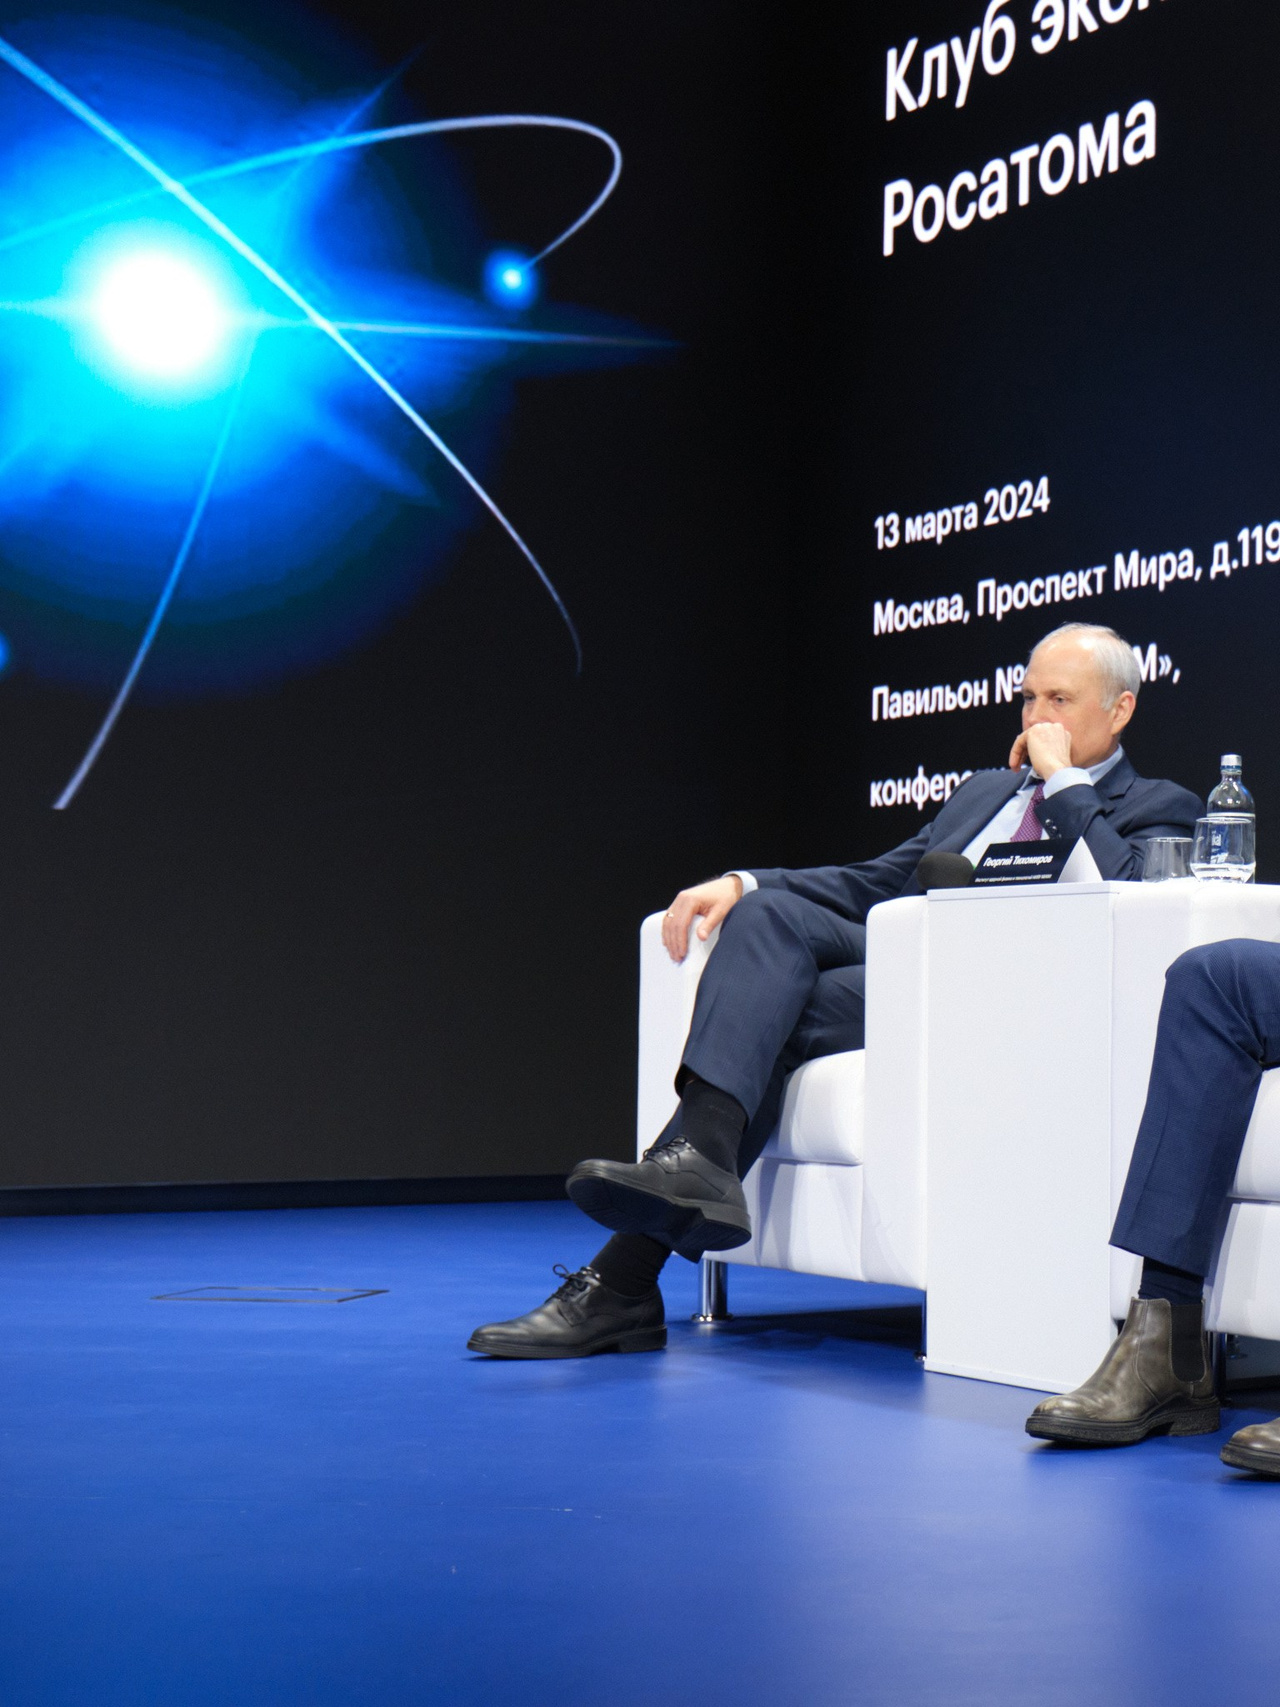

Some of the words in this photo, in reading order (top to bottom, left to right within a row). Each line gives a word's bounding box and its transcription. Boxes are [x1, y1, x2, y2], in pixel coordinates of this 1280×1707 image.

[885, 0, 1016, 121] Клуб
[1031, 0, 1150, 54] эк
[882, 99, 1157, 257] Росатома
[874, 512, 900, 550] 13
[905, 501, 979, 545] марта
[984, 476, 1051, 526] 2024
[873, 593, 970, 636] Москва,
[977, 565, 1108, 622] Проспект
[1114, 548, 1203, 592] Мира,
[871, 678, 989, 722] Павильон
[983, 855, 1014, 868] Георгий
